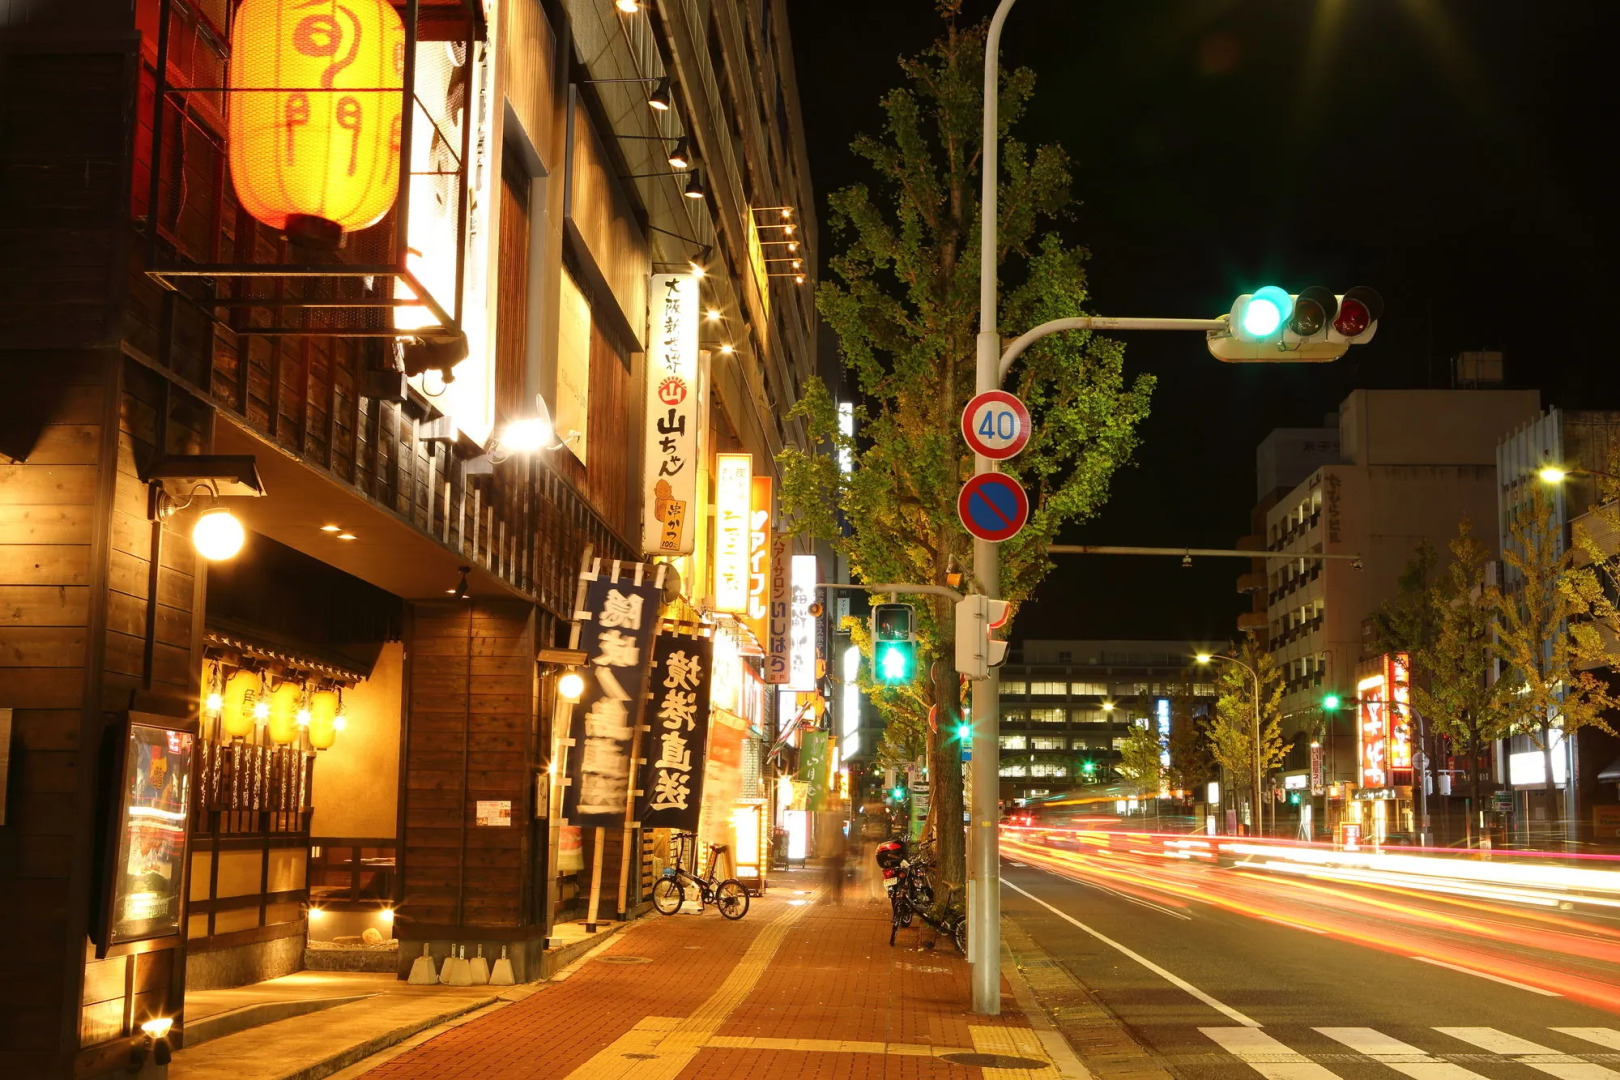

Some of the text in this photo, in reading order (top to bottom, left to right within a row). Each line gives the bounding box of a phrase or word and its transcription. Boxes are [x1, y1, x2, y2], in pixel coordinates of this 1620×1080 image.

[657, 408, 687, 477] 山ちゃん
[979, 410, 1015, 440] 40
[666, 502, 681, 540] 串かつ
[770, 602, 786, 673] いしはら
